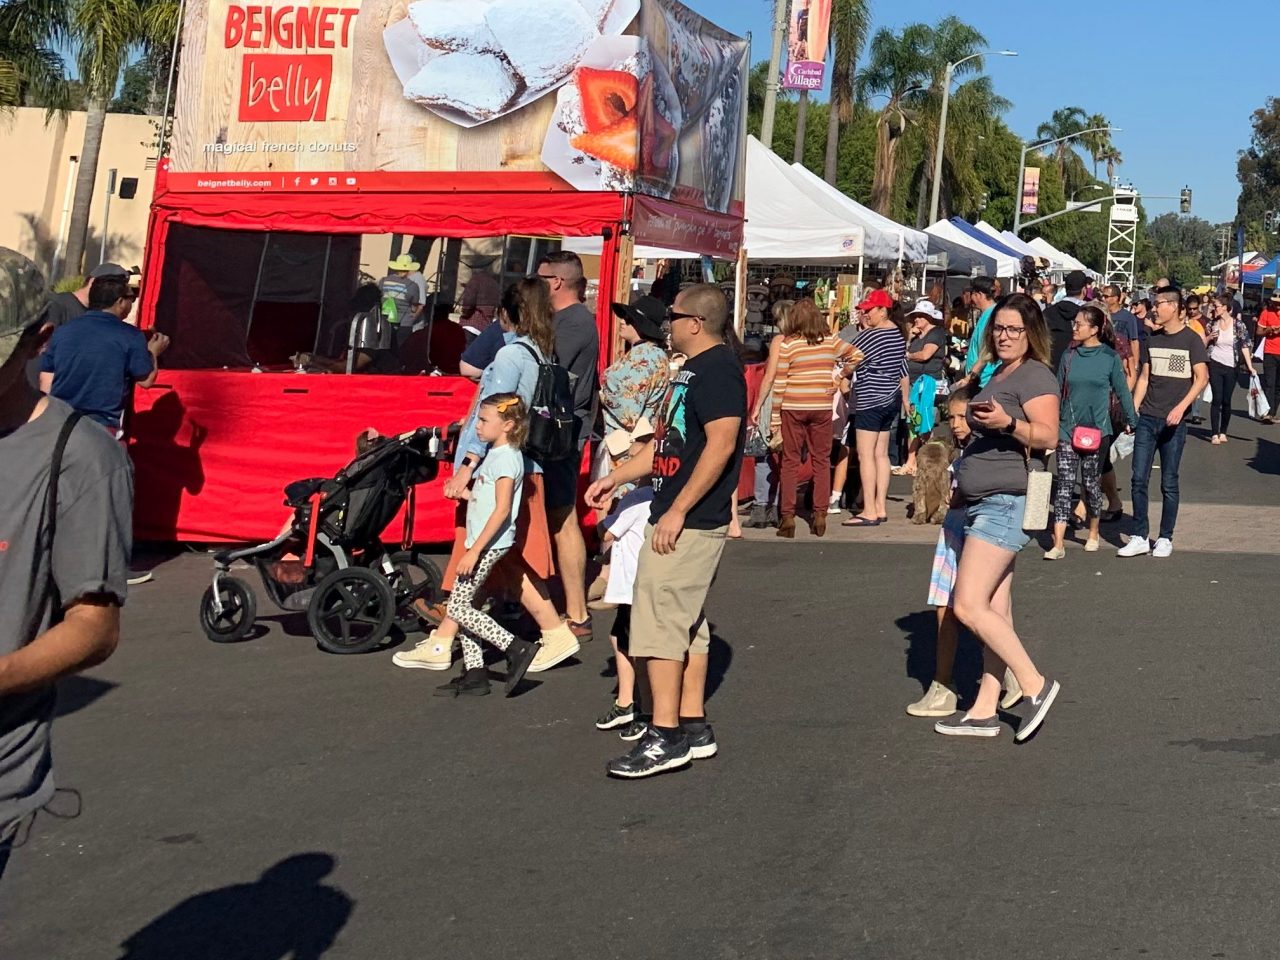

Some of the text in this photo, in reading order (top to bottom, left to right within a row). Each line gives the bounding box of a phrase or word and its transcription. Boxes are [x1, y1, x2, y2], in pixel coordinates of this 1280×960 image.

[224, 5, 360, 49] BEIGNET
[788, 75, 821, 88] Village
[247, 61, 323, 121] belly
[203, 140, 357, 155] magical french donuts
[197, 178, 272, 189] beignetbelly.com
